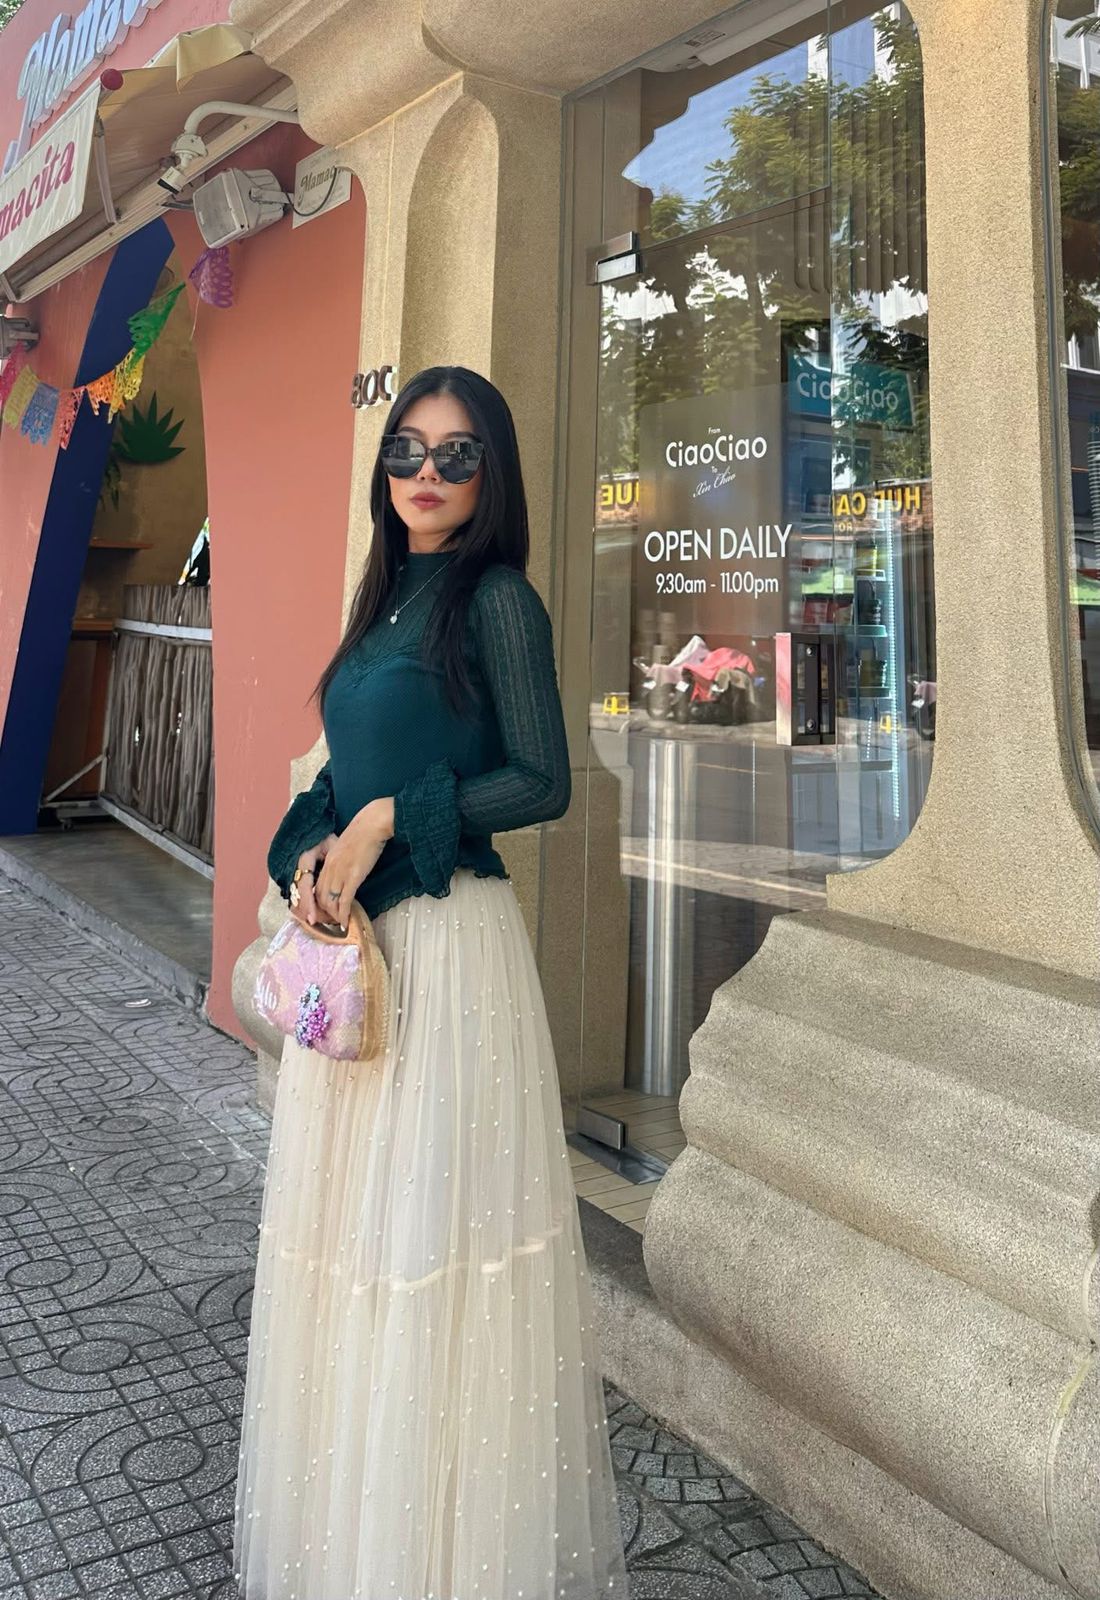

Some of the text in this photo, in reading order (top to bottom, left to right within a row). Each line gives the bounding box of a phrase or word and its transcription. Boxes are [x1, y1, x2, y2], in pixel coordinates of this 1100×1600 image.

[665, 434, 767, 468] CiaoCiao
[644, 523, 793, 563] OPEN DAILY
[655, 572, 707, 594] 9.30am
[719, 571, 779, 600] 11.00pm
